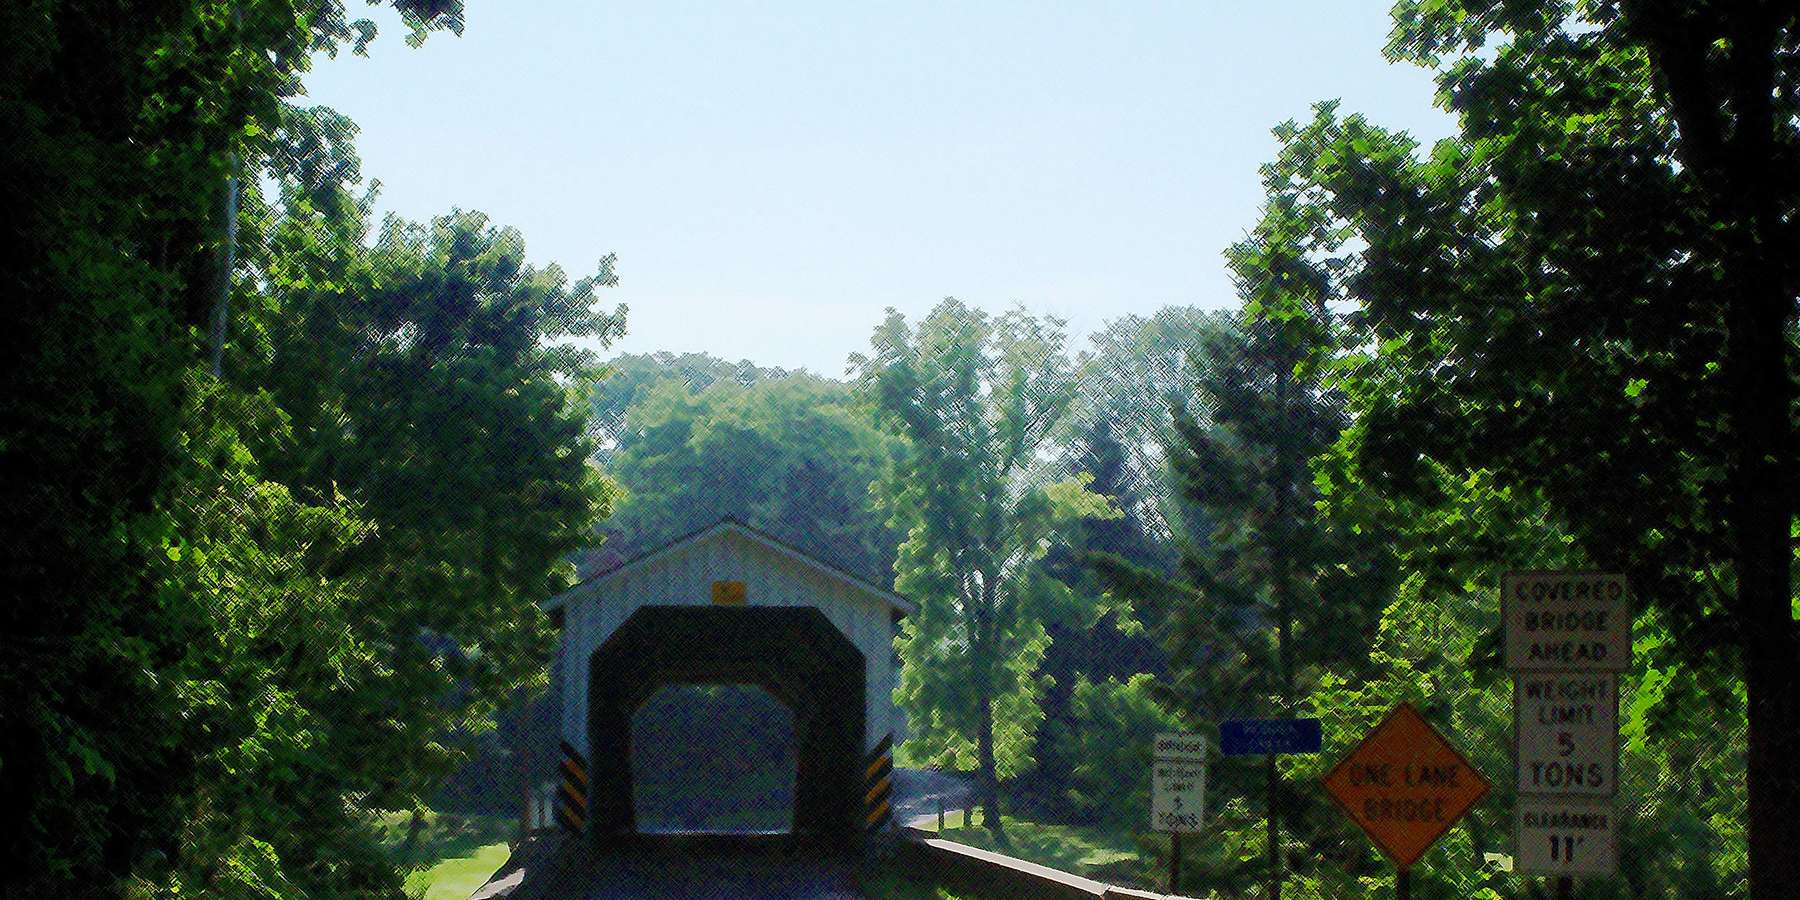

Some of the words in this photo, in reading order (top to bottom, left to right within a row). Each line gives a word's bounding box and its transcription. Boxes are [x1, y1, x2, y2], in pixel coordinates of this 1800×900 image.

[1524, 610, 1608, 632] BRIDGE
[1528, 641, 1607, 663] AHEAD
[1526, 680, 1608, 700] WEIGHT
[1537, 704, 1593, 724] LIMIT
[1558, 731, 1576, 757] 5
[1349, 763, 1391, 787] ONE
[1404, 763, 1461, 788] LANE
[1529, 761, 1604, 788] TONS
[1364, 797, 1446, 823] BRIDGE
